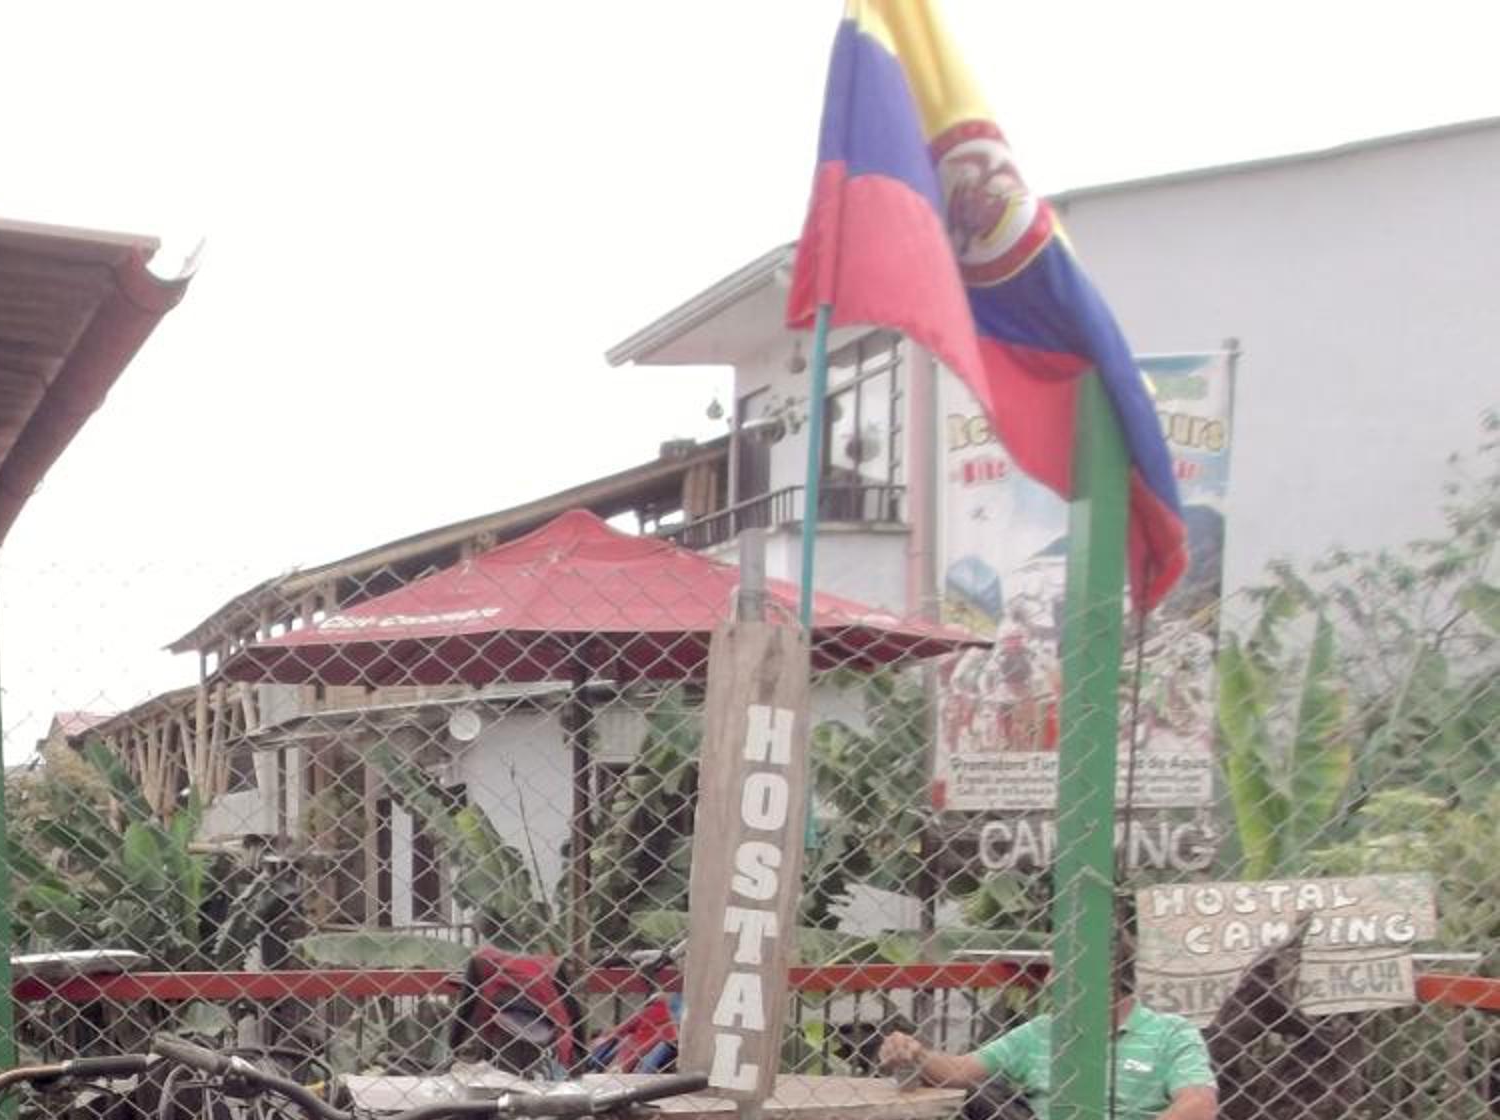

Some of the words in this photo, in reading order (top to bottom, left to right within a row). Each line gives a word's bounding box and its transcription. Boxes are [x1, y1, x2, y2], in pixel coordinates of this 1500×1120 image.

[707, 704, 796, 1091] HOSTAL
[1152, 884, 1358, 917] HOSTAL
[1184, 914, 1416, 954] CAMPING
